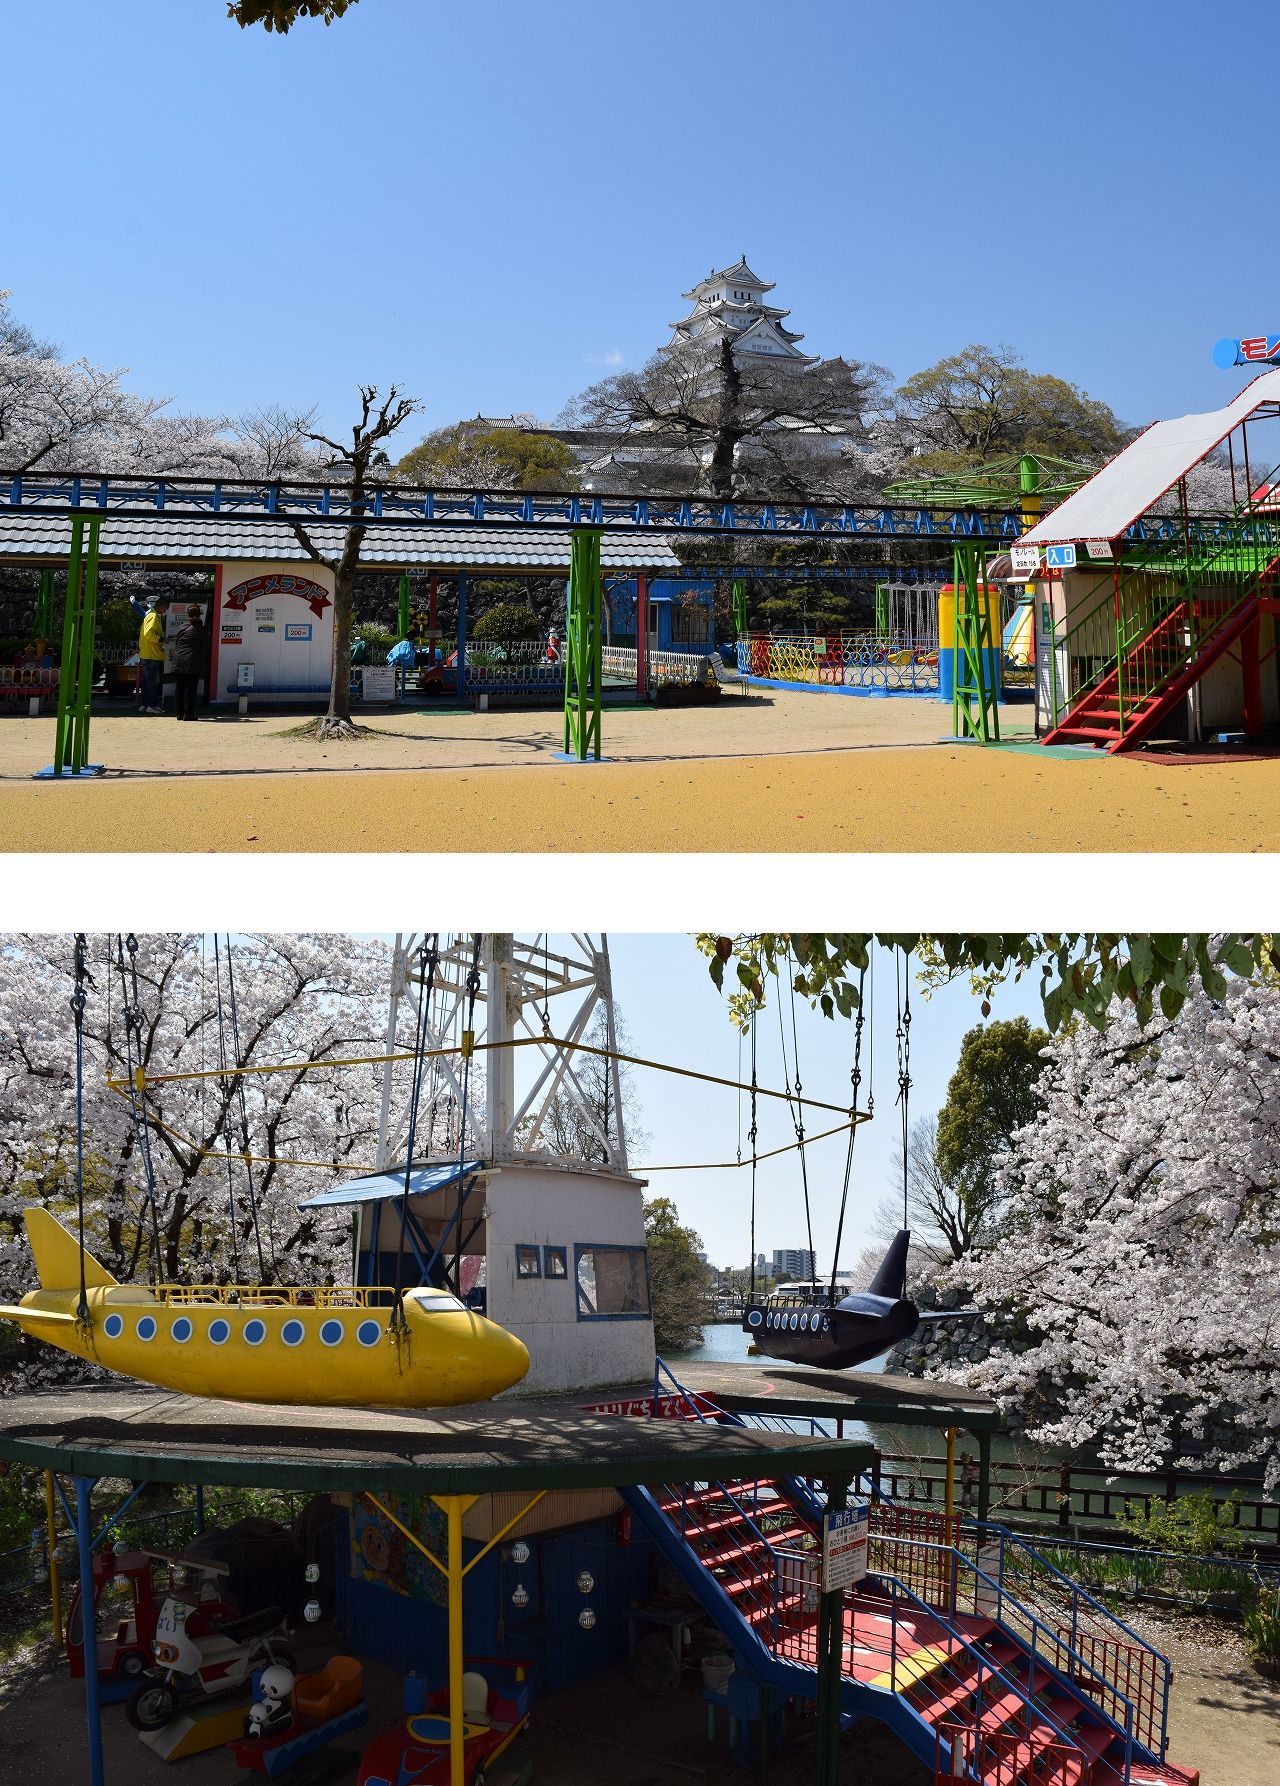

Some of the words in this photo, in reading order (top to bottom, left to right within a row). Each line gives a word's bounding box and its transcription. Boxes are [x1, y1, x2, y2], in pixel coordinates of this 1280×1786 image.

[1015, 548, 1035, 556] モノレール
[1049, 548, 1072, 563] 入口
[231, 576, 327, 605] アニメランド
[835, 1509, 859, 1527] 飛行塔
